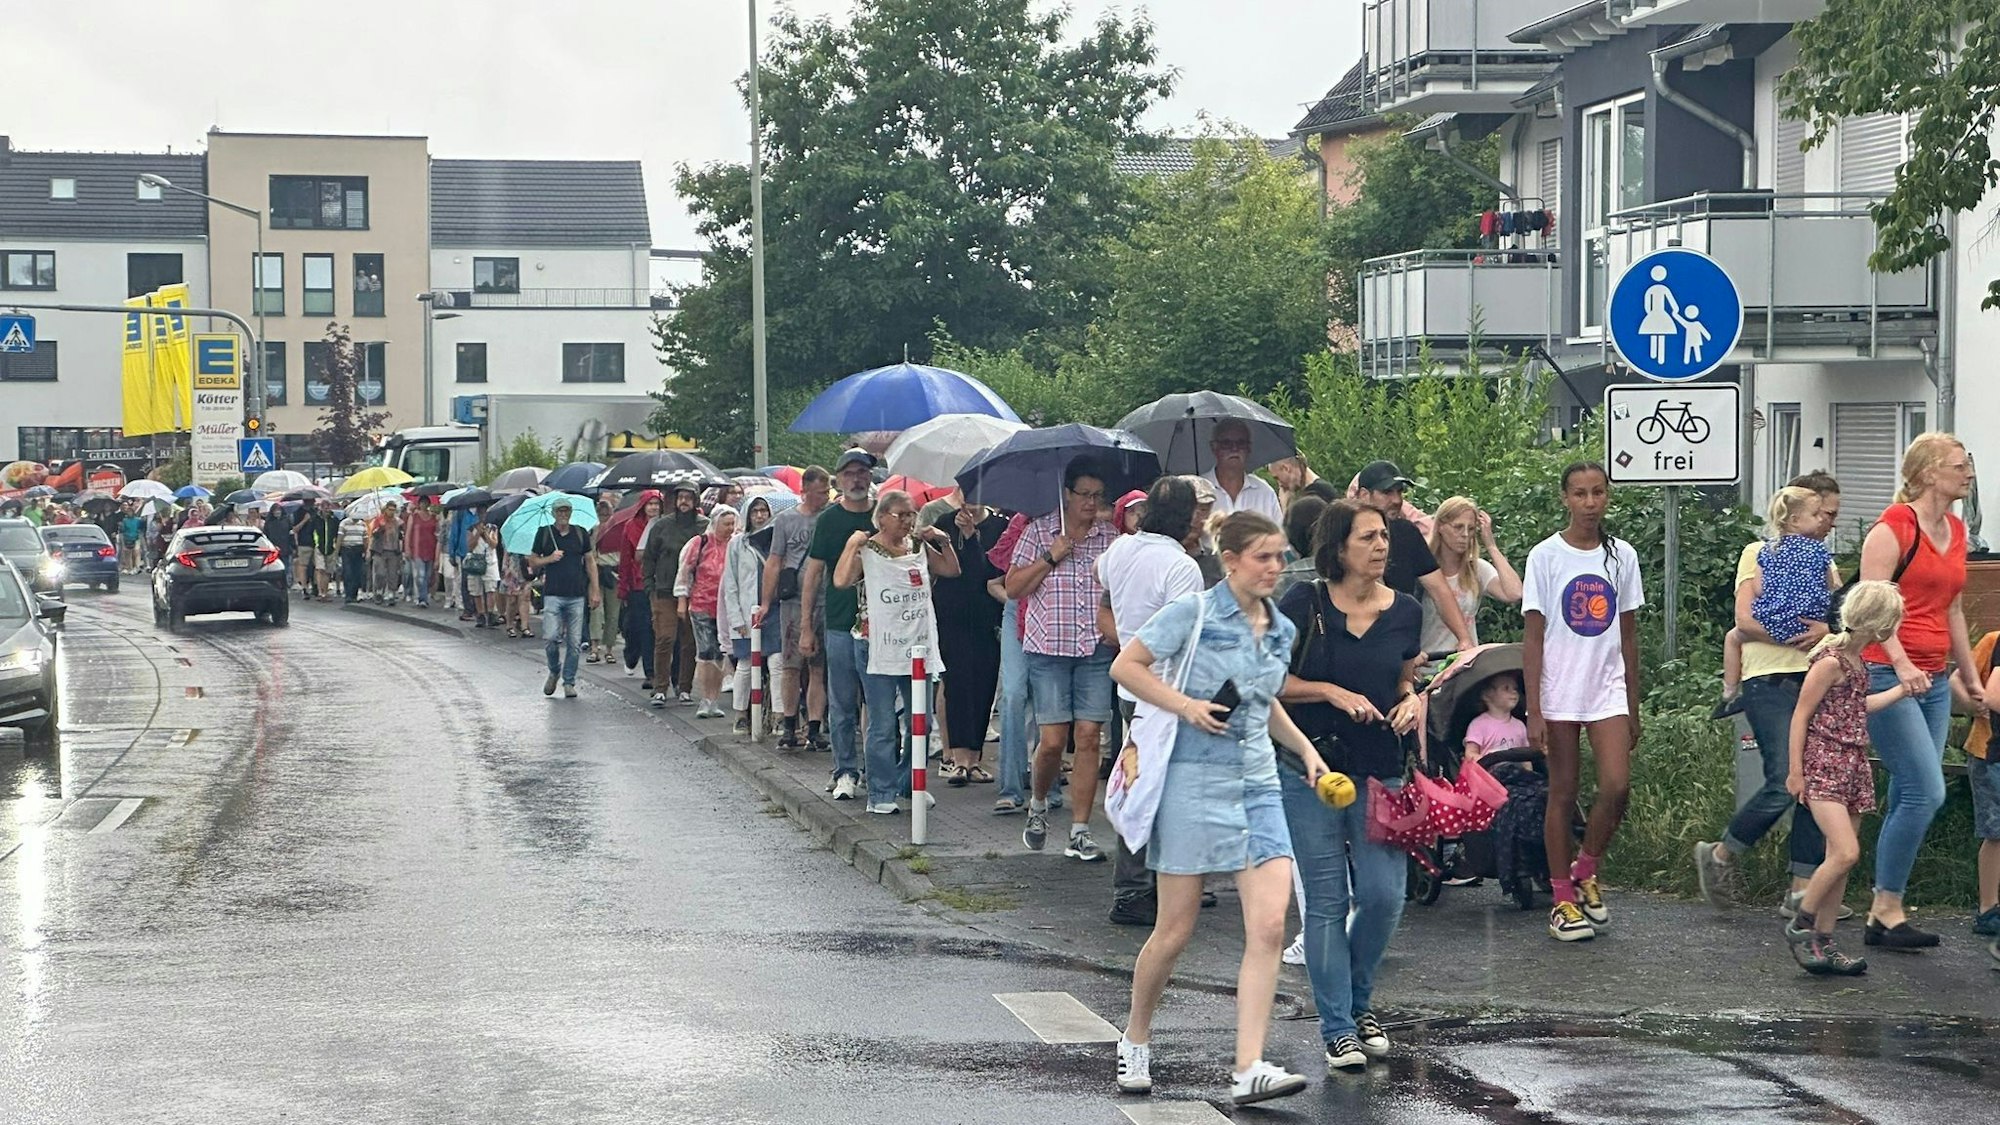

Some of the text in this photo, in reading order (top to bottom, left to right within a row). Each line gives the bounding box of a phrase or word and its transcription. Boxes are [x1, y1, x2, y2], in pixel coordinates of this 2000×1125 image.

[198, 377, 235, 385] EDEKA
[197, 393, 238, 404] Kötter
[197, 423, 237, 435] Müller
[1654, 450, 1693, 470] frei
[197, 462, 239, 471] KLEMENT
[1575, 581, 1604, 592] finale
